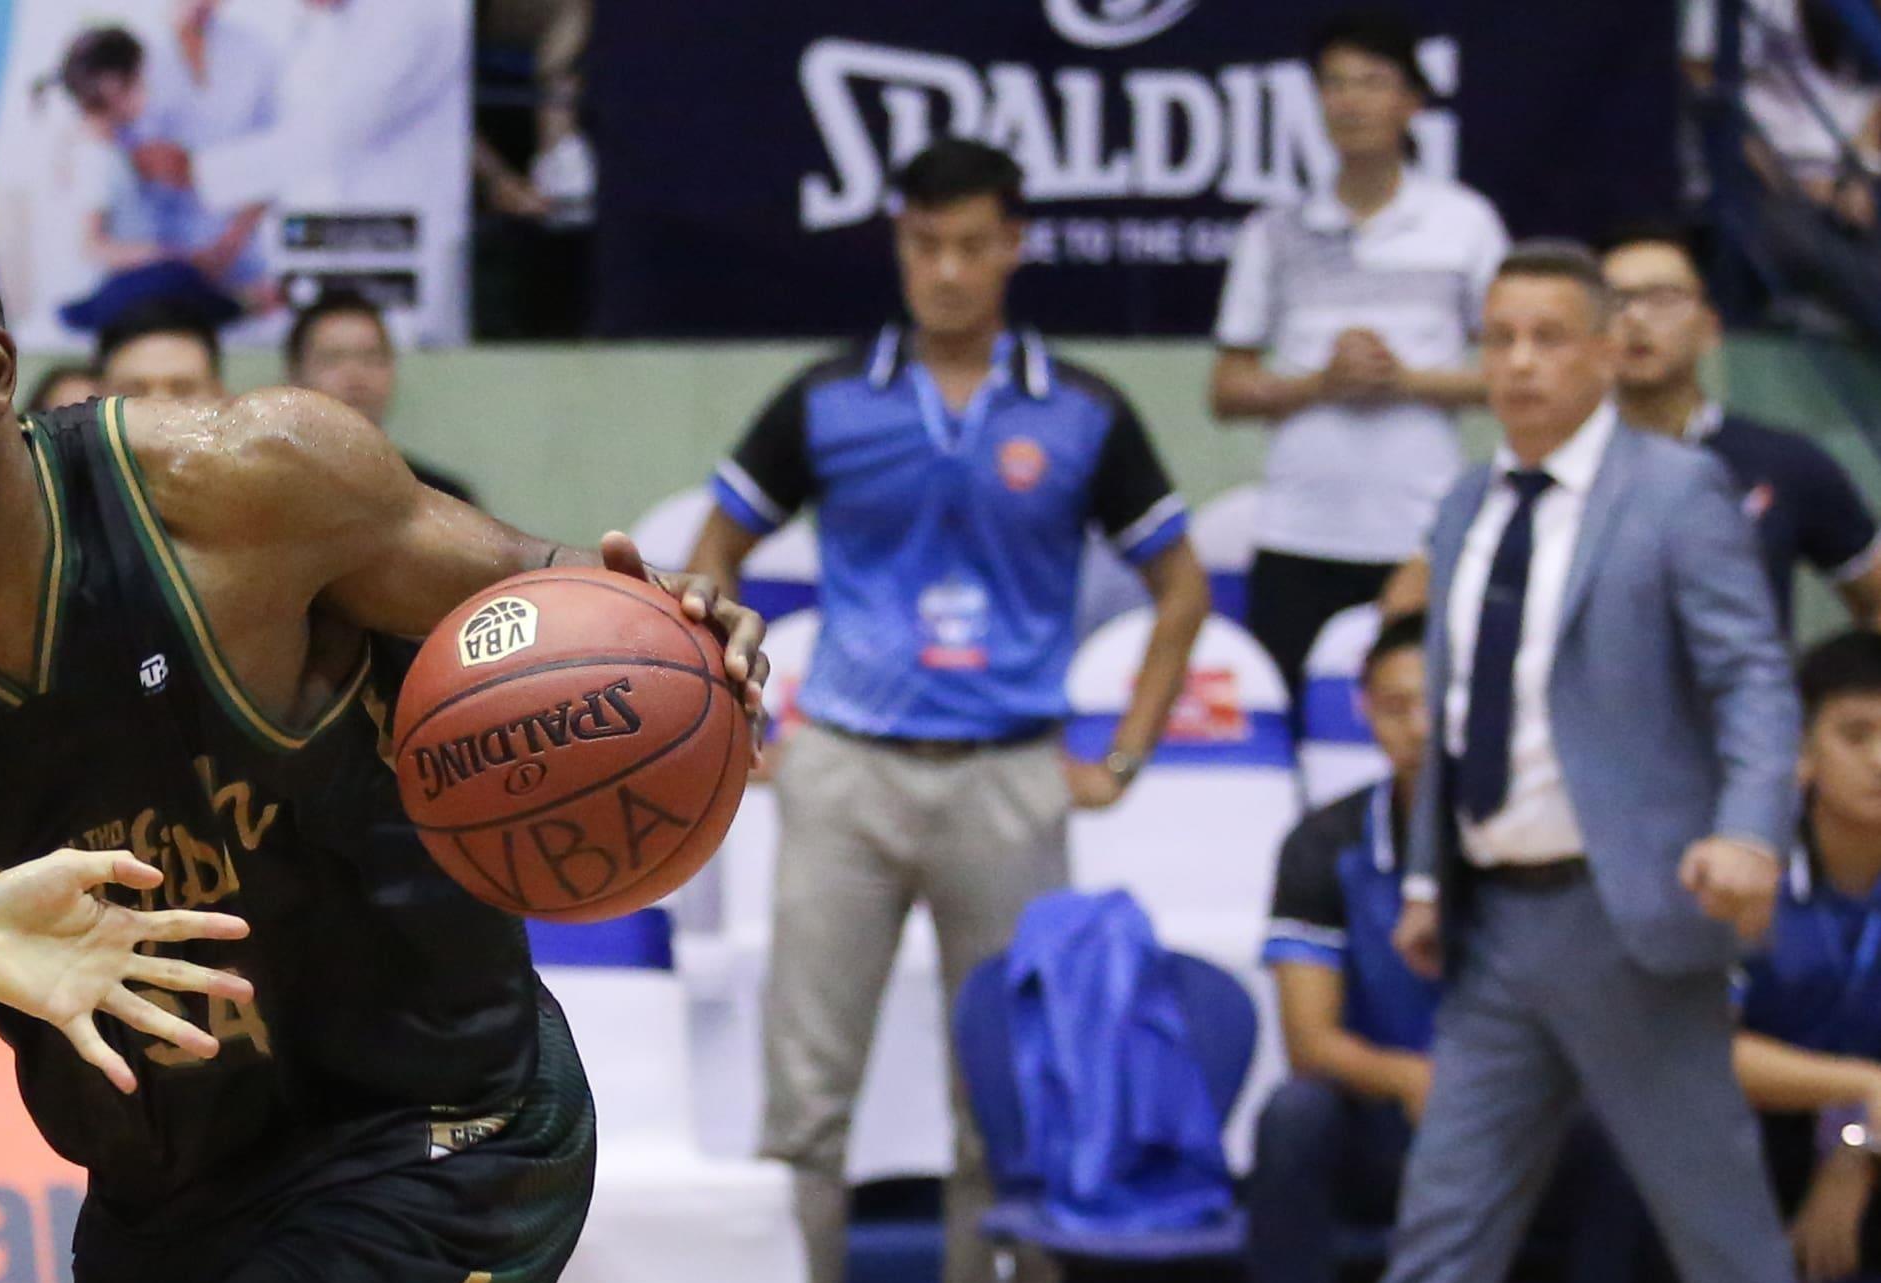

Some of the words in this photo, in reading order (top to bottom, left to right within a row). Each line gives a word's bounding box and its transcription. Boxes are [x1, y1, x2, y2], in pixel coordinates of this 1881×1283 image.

[465, 621, 526, 661] VBA
[413, 676, 642, 802] SPALDING
[451, 783, 693, 906] VBA
